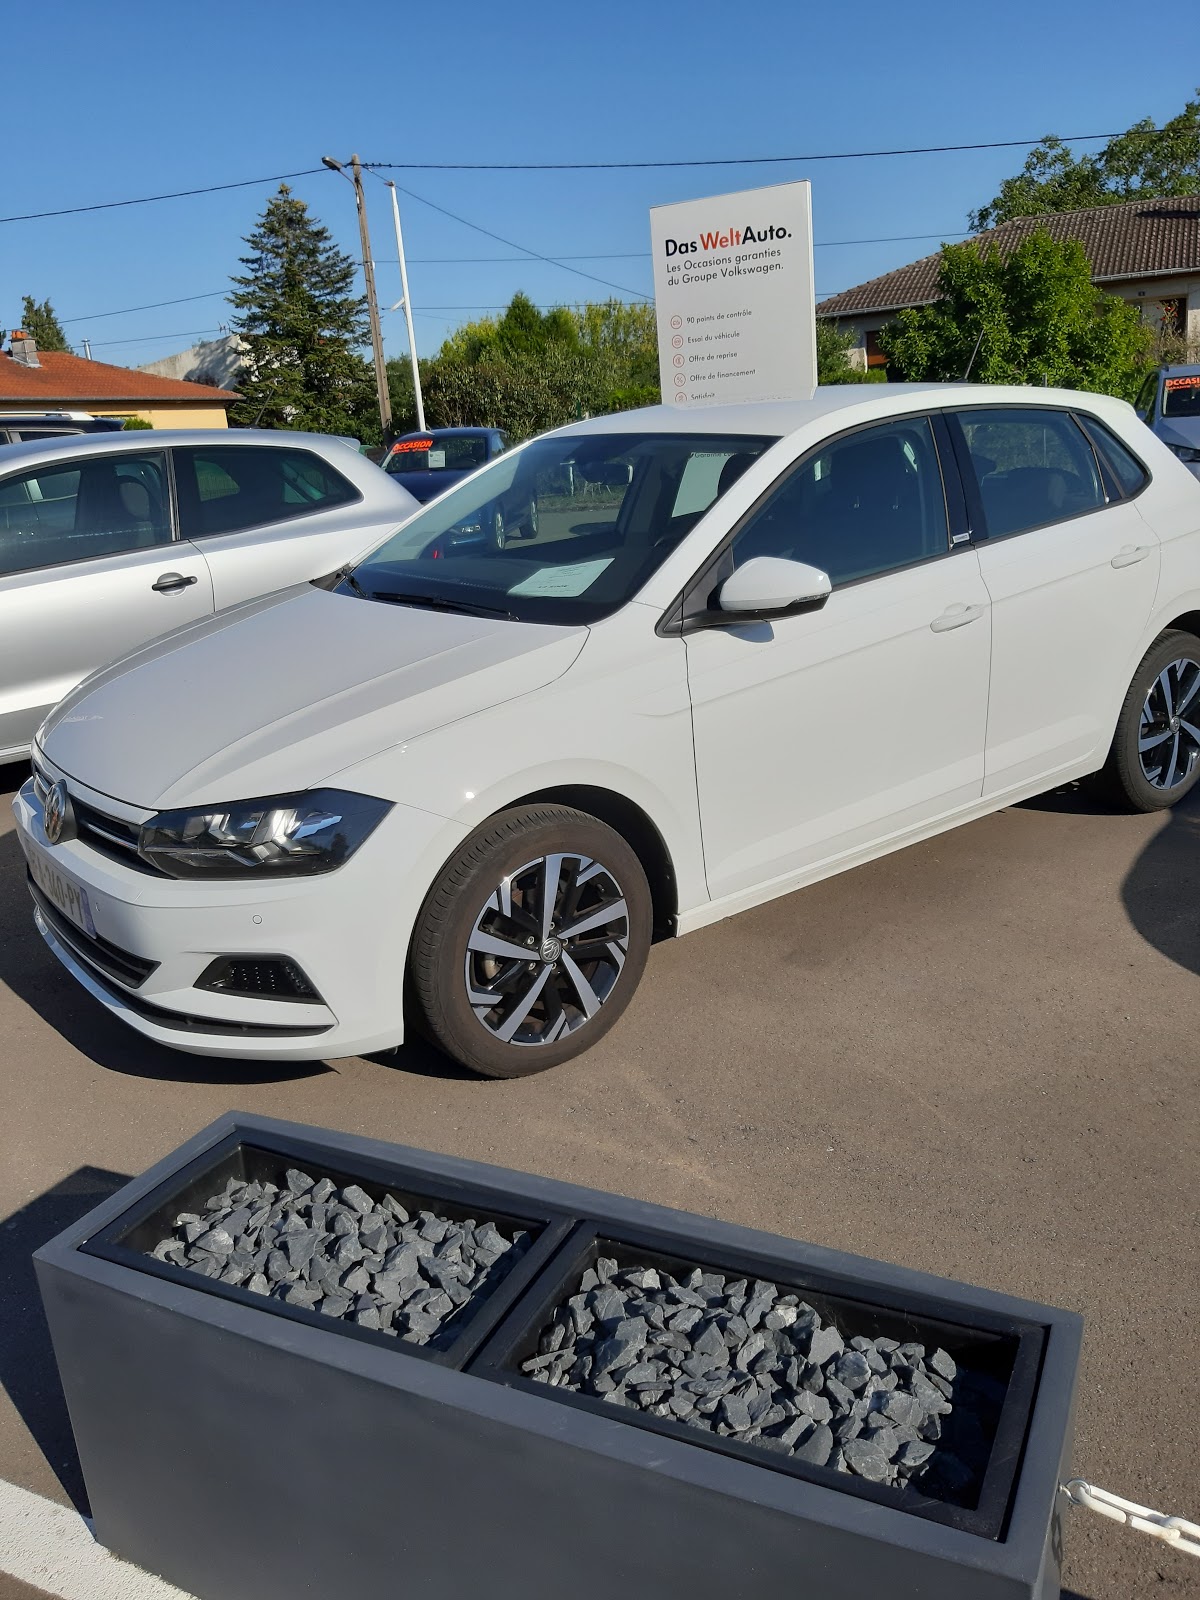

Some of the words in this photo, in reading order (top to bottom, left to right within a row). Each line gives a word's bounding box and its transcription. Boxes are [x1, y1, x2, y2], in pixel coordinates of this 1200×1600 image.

[665, 238, 698, 257] Das
[666, 263, 681, 273] Les
[683, 256, 732, 270] Occasions
[734, 248, 781, 264] garanties
[667, 276, 680, 286] du
[682, 271, 718, 284] Groupe
[720, 262, 784, 278] Volkswagen.
[686, 316, 695, 324] 90
[696, 315, 715, 324] points
[726, 309, 752, 319] contrôle
[687, 336, 703, 344] Essai
[714, 330, 740, 340] véhicule
[688, 355, 705, 363] Offre
[706, 353, 715, 361] de
[716, 351, 738, 360] reprise
[689, 374, 706, 382] Offre
[717, 369, 756, 379] financement
[393, 440, 434, 451] OCCASION
